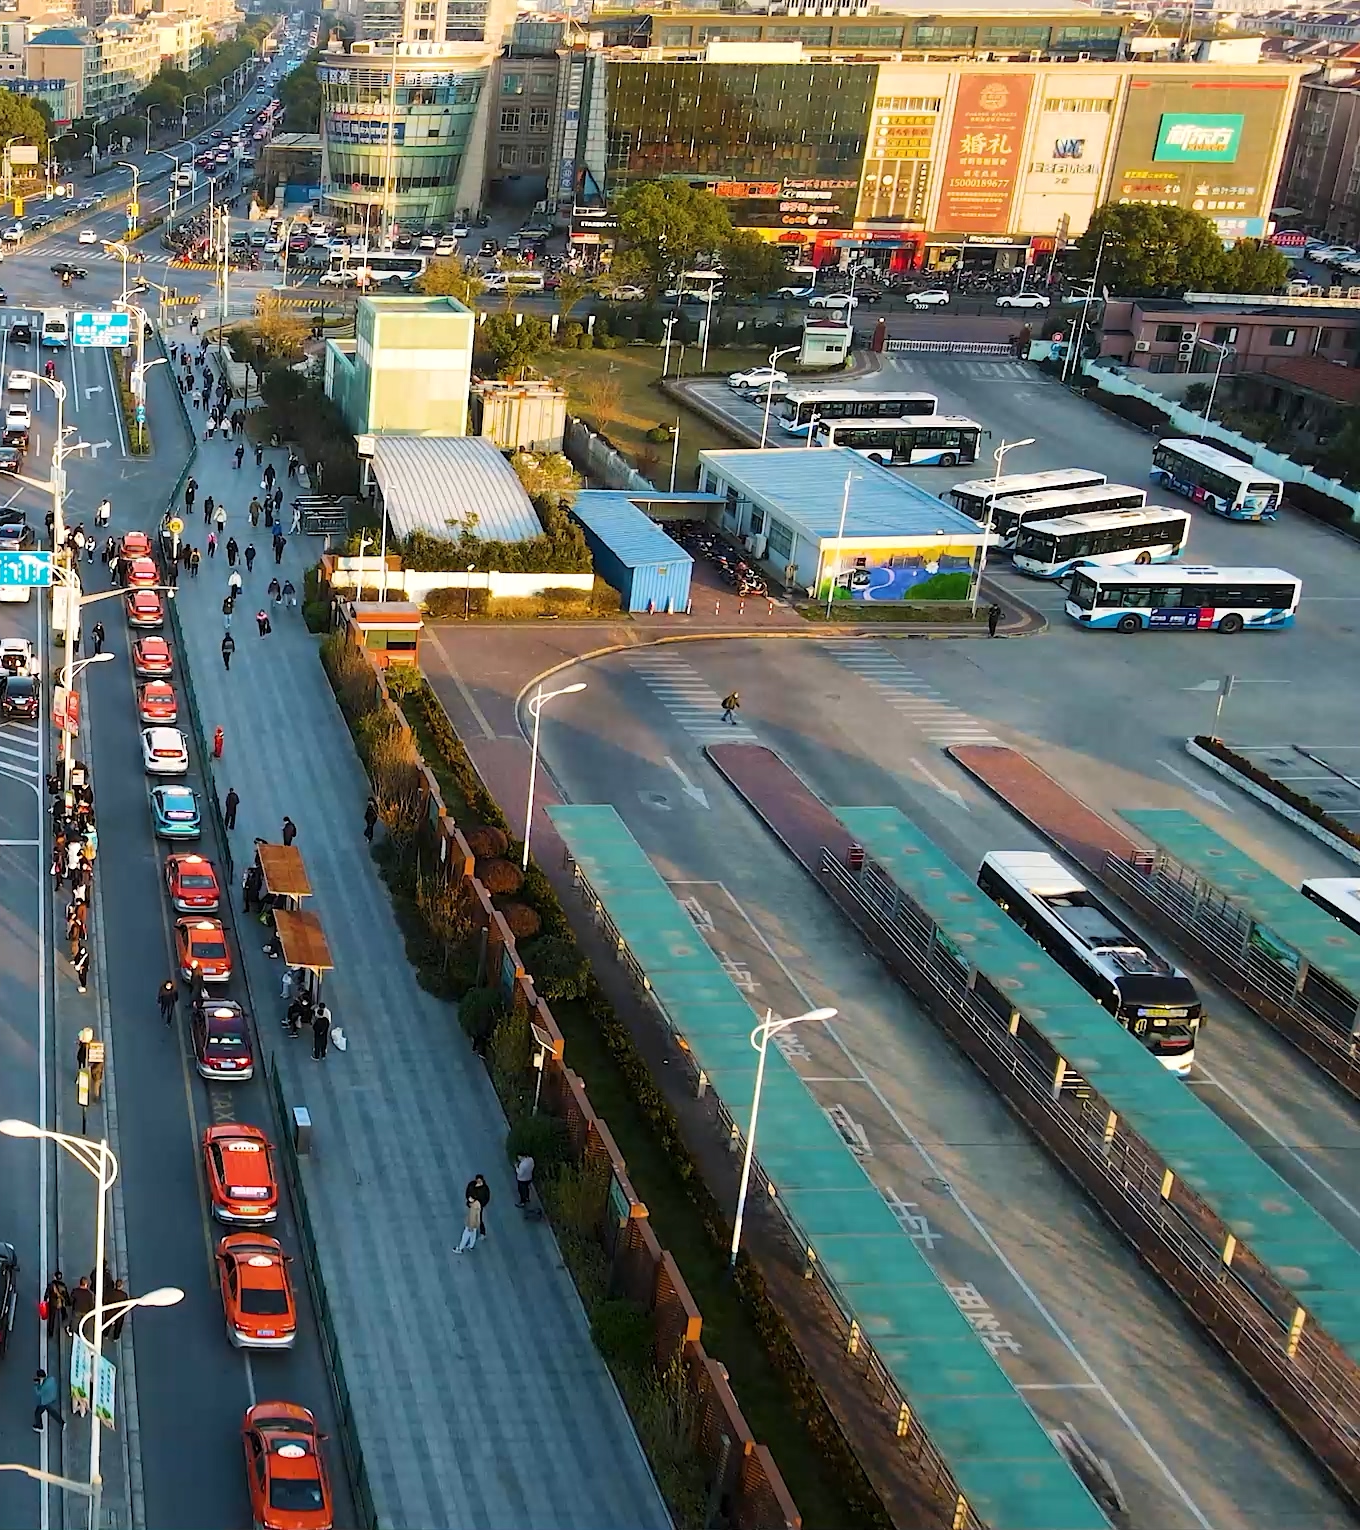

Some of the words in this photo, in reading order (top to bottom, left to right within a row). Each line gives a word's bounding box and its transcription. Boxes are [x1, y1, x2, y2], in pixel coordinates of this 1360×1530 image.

[958, 132, 1012, 155] 婚礼
[1165, 124, 1235, 151] 新东方
[949, 178, 1010, 188] 15000189677
